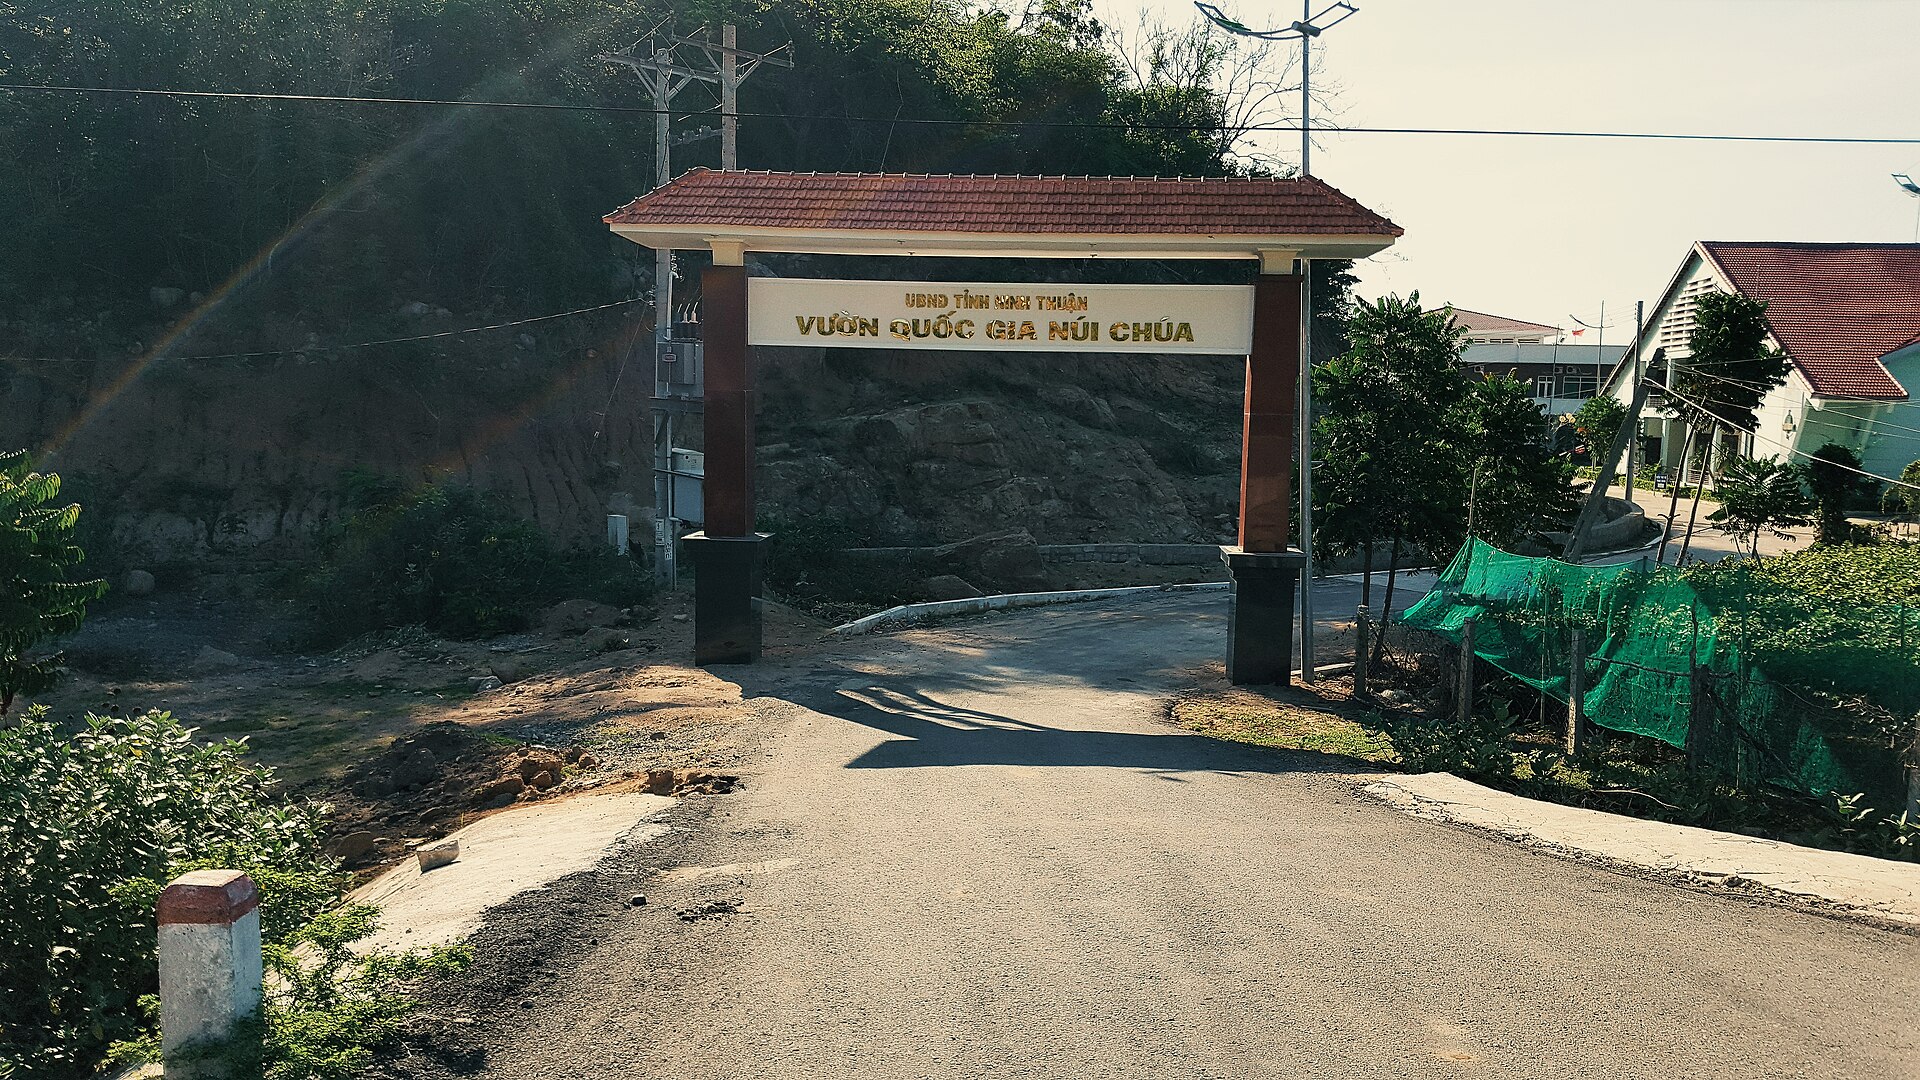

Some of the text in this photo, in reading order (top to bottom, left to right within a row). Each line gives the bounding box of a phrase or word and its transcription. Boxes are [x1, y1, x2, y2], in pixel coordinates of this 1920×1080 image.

[905, 293, 948, 308] UBND
[954, 289, 990, 309] TỈNH
[1036, 292, 1088, 313] THUẬN
[795, 310, 1194, 342] VƯỜN QUỐC GIA NÚI CHÚA
